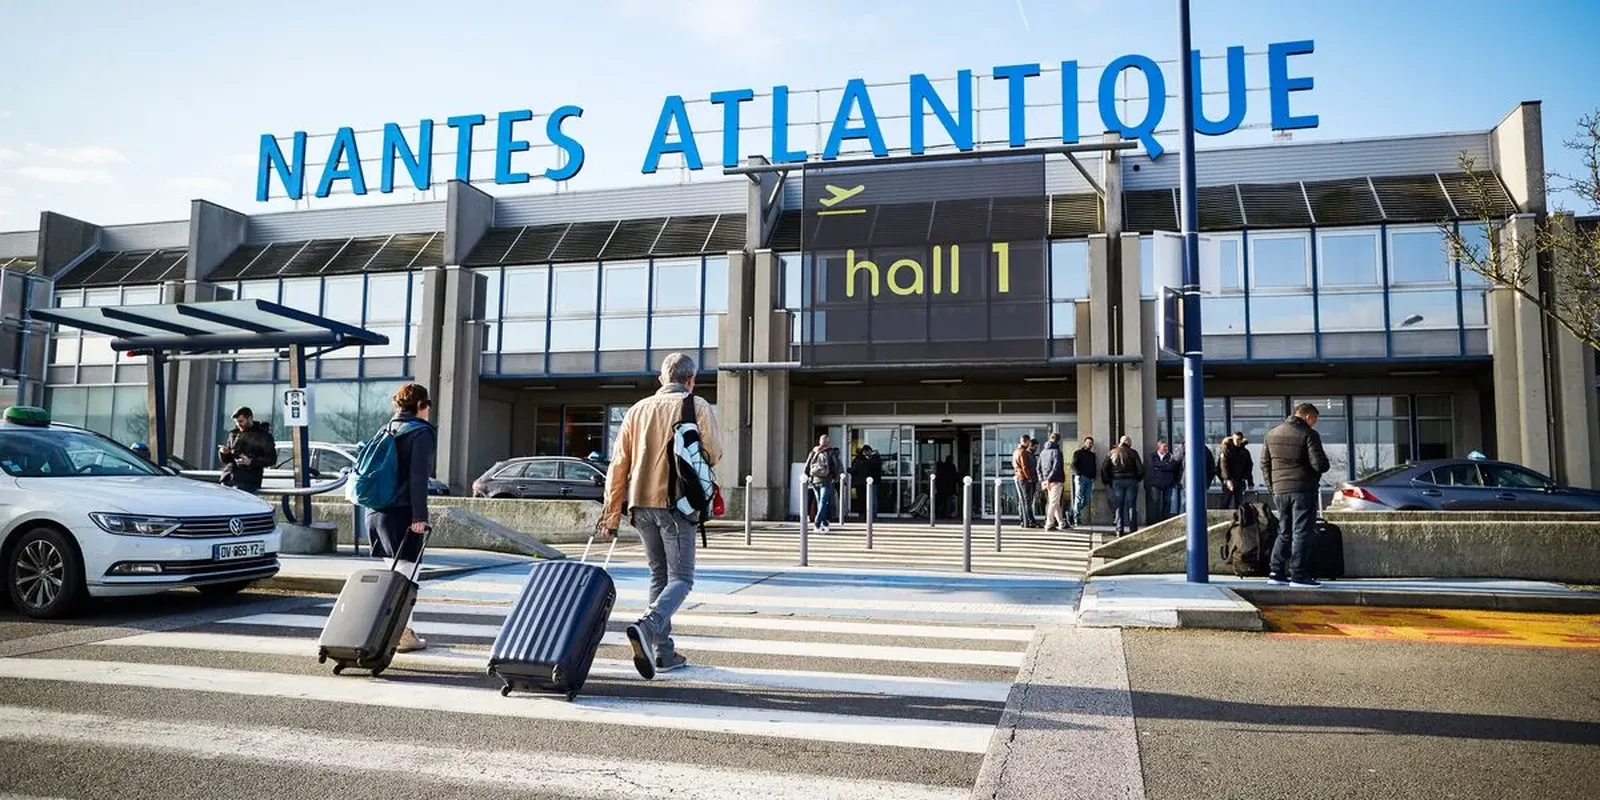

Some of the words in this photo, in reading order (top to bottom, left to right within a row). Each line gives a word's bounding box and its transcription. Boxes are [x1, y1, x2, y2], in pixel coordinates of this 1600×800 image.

[256, 105, 585, 202] NANTES
[641, 39, 1320, 174] ATLANTIQUE
[845, 245, 960, 298] hall
[992, 242, 1010, 293] 1
